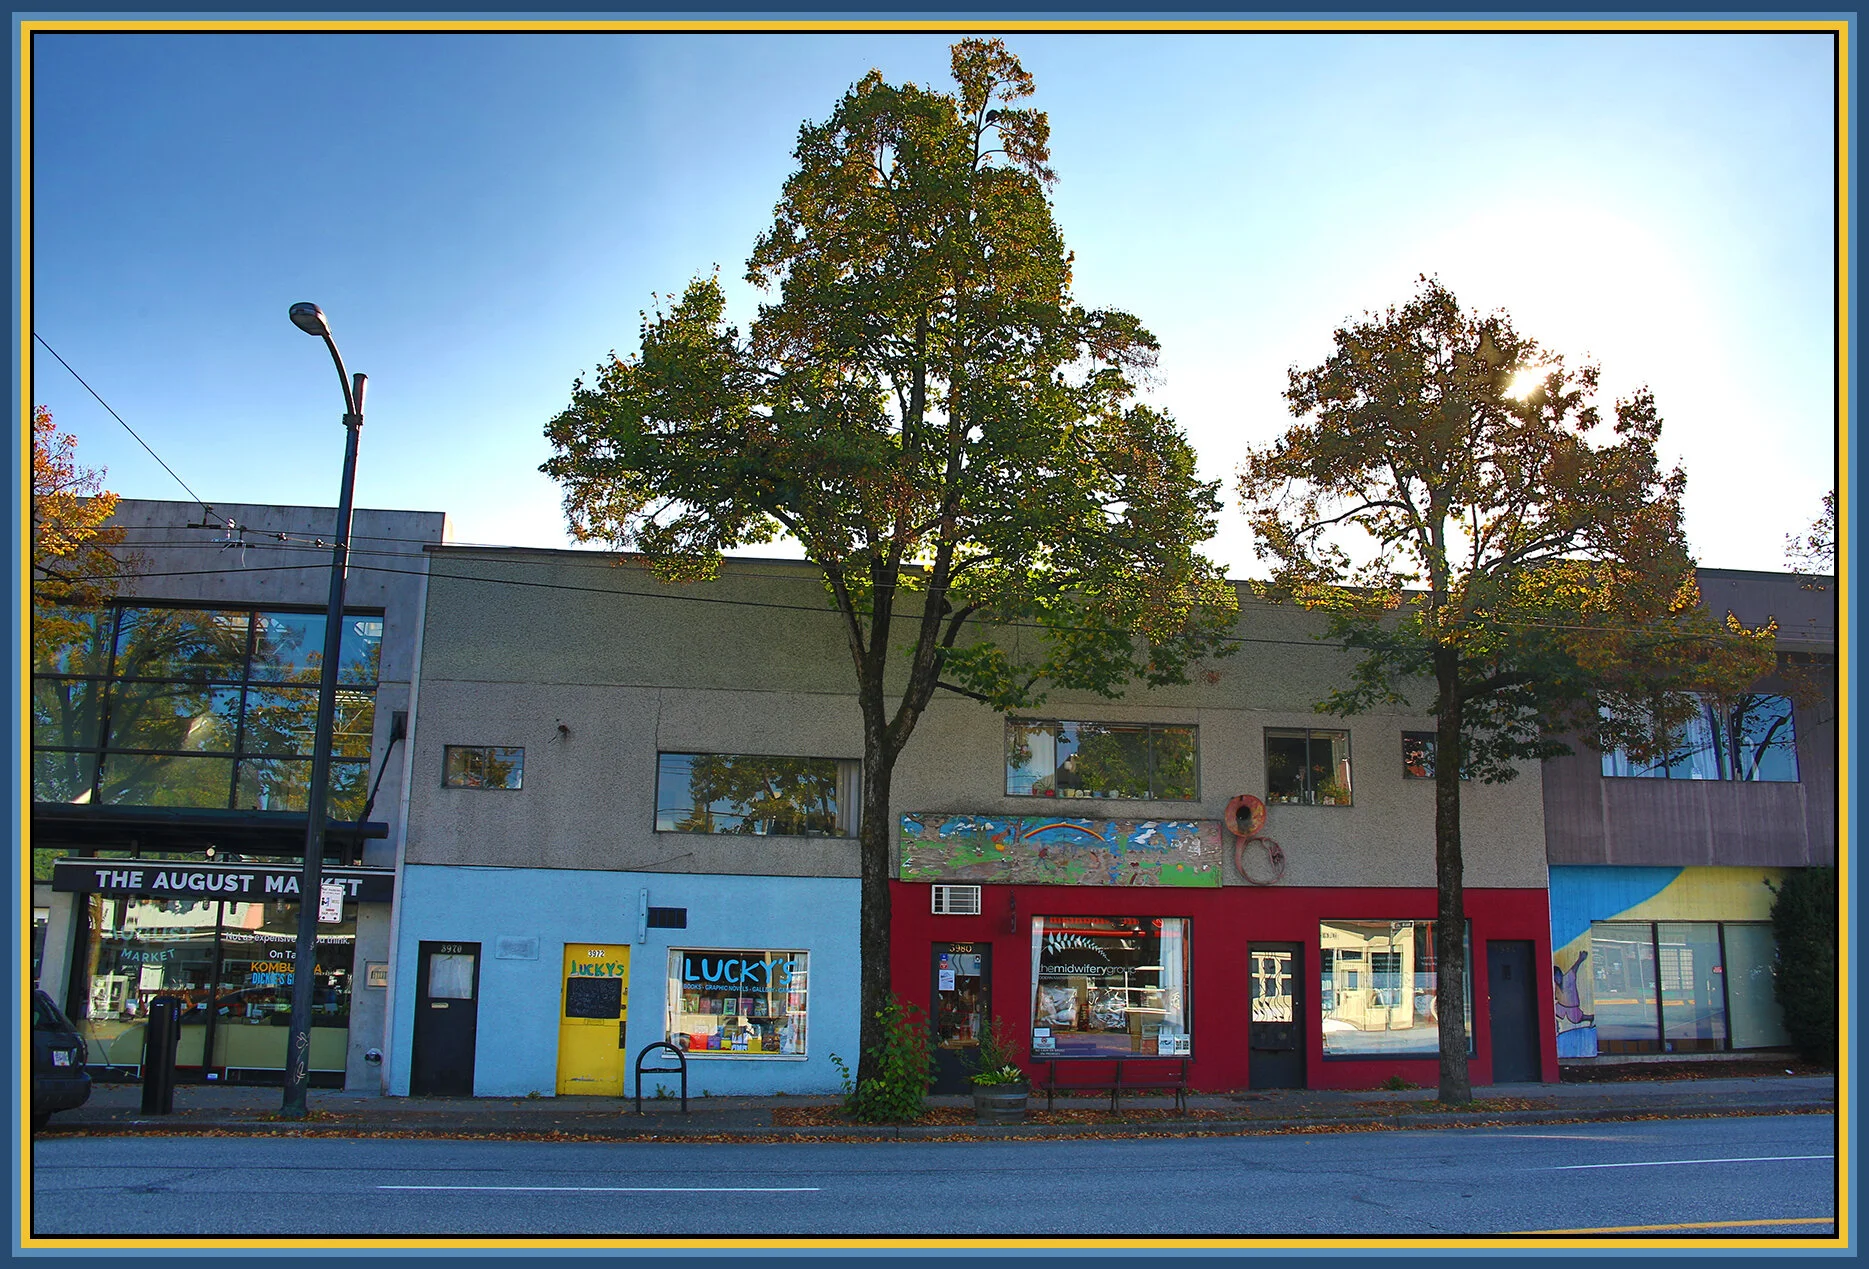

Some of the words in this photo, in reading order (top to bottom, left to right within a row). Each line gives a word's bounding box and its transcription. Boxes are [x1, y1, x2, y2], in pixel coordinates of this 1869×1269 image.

[96, 870, 144, 888] THE
[152, 872, 254, 892] AUGUST
[265, 876, 363, 897] MAET
[110, 925, 195, 942] AUGUST
[225, 932, 241, 941] Not
[254, 934, 296, 944] expensive
[269, 950, 283, 959] On
[285, 951, 297, 959] Ta
[440, 944, 462, 953] 3970
[949, 943, 972, 953] 3980
[121, 948, 176, 962] MARKET
[251, 962, 322, 974] KOMBUA
[570, 960, 625, 977] LUCKY'S
[685, 958, 797, 985] LUCKY'S
[252, 972, 285, 985] DICKIE'S
